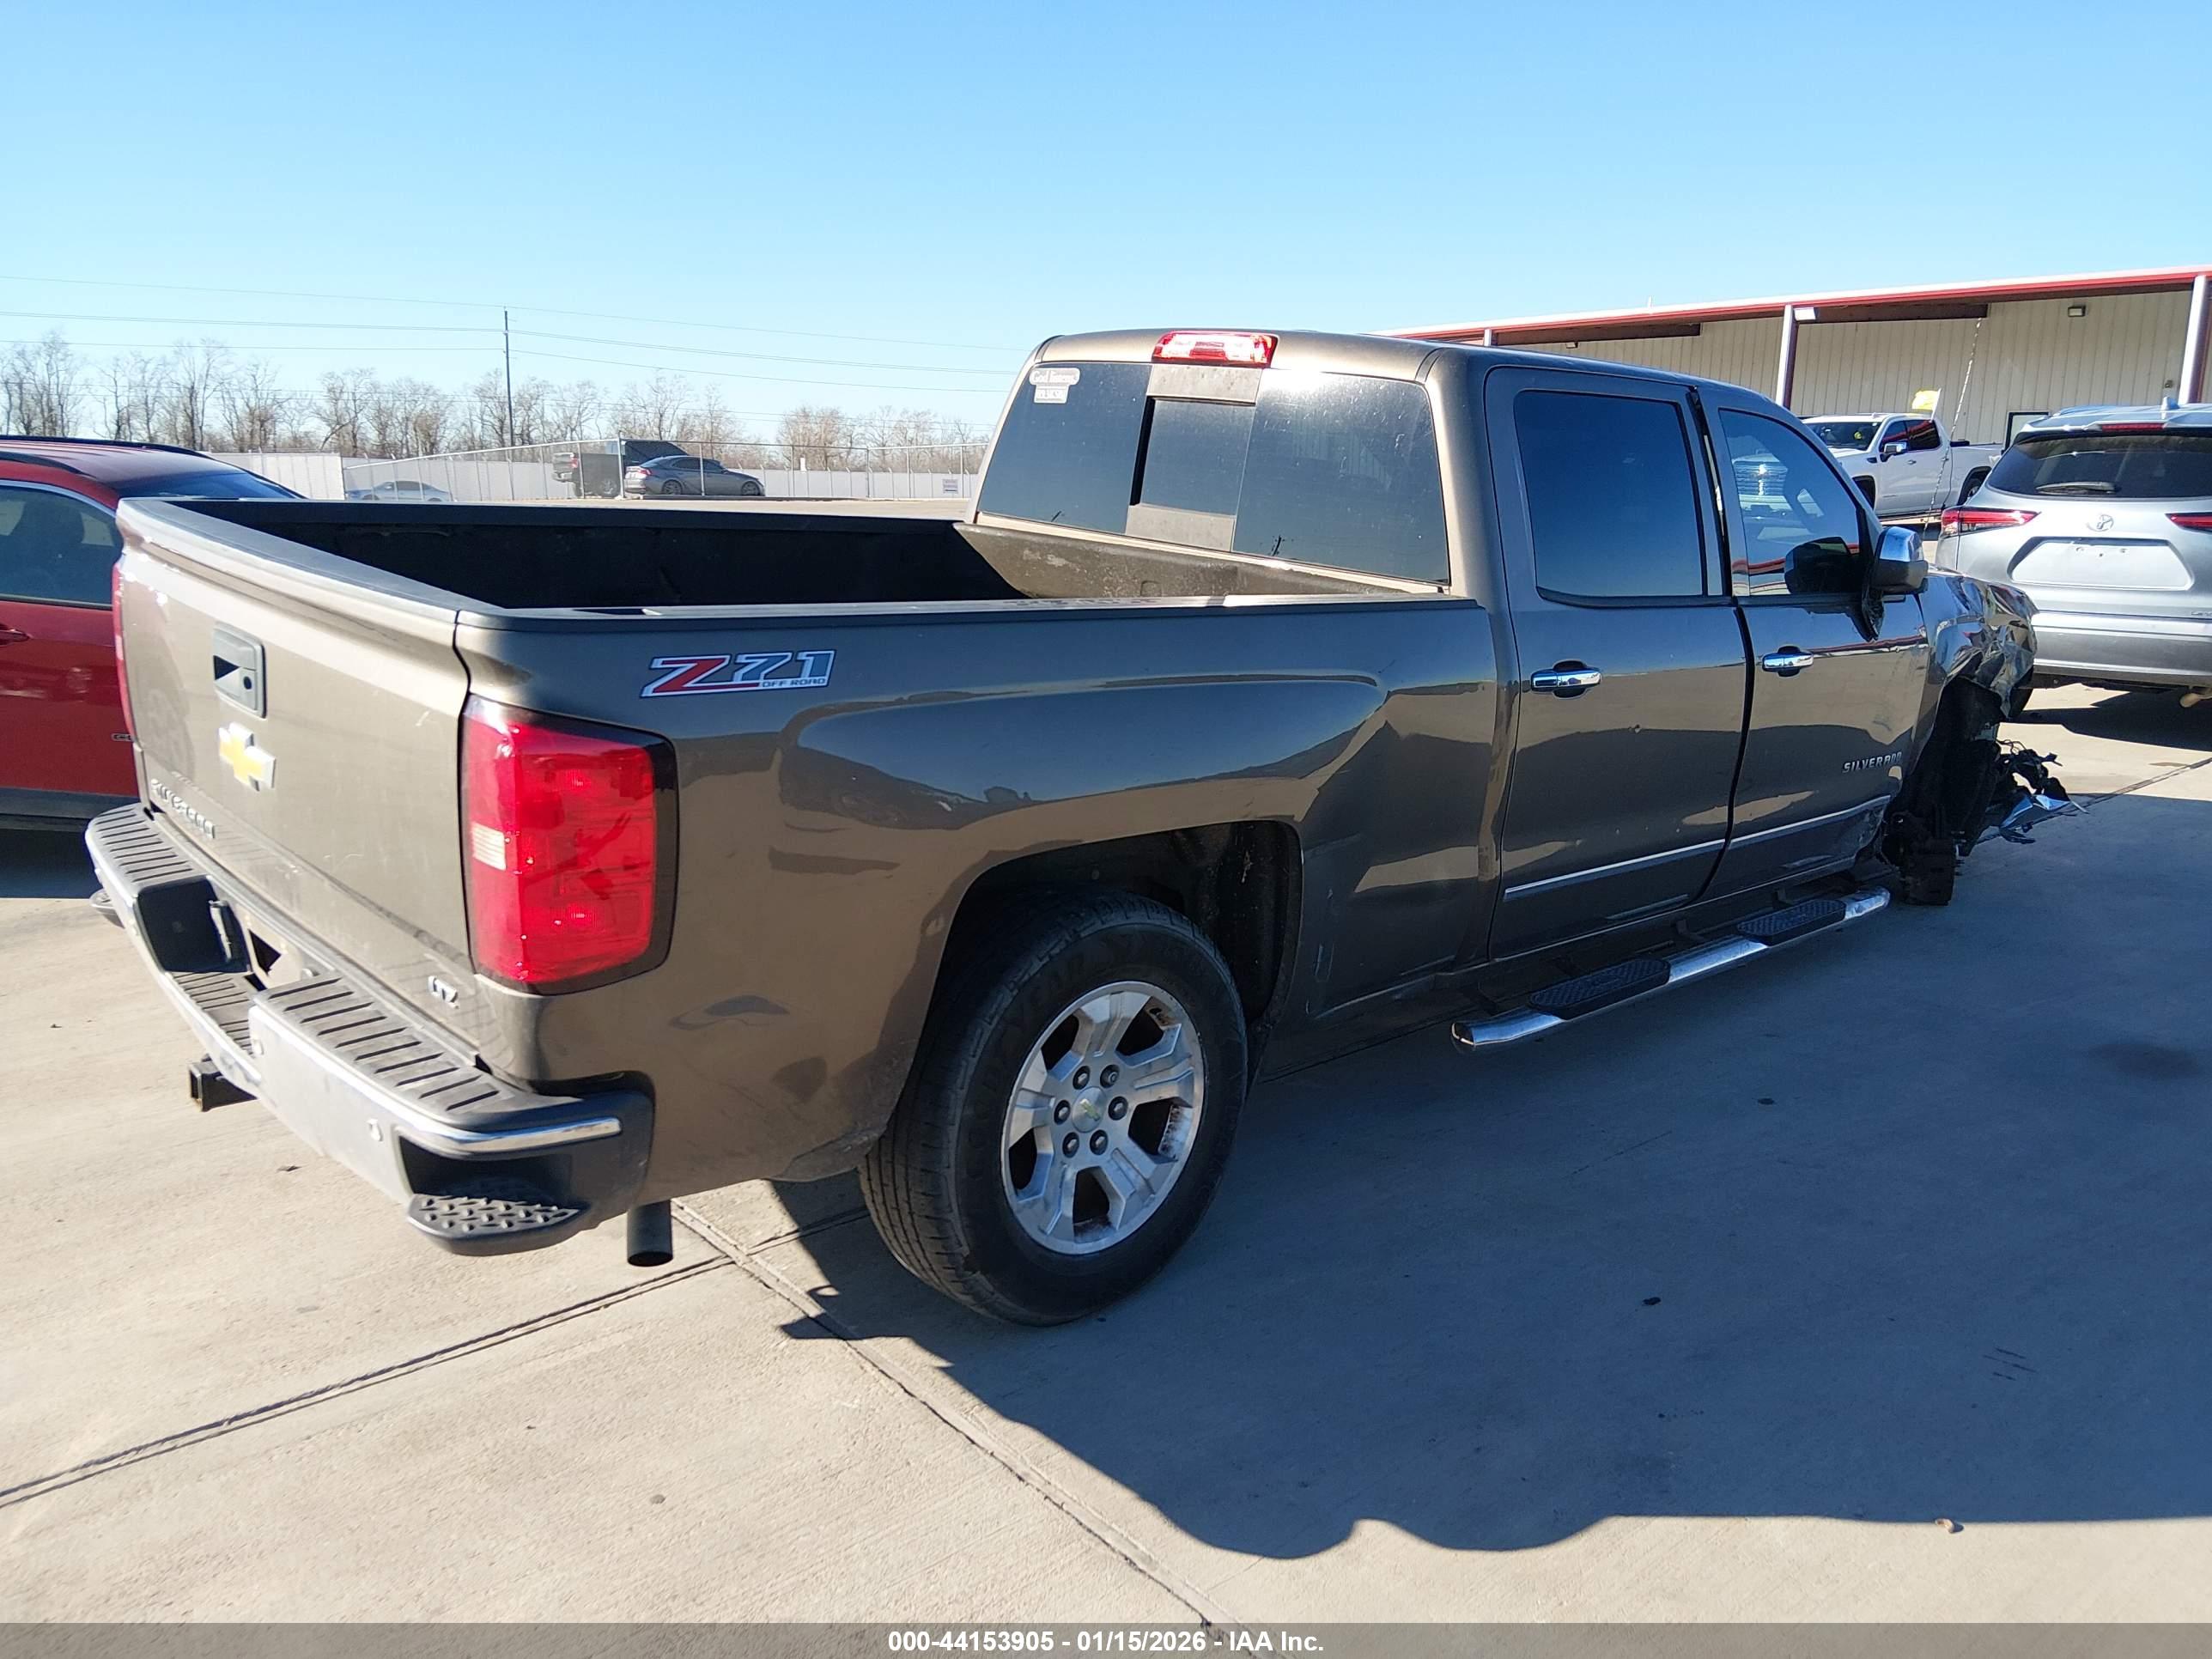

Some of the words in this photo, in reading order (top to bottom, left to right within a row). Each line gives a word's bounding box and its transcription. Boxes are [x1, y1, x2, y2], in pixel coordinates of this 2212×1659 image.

[639, 649, 836, 698] Z71
[762, 680, 785, 689] OFF
[789, 677, 826, 687] ROAD
[1841, 750, 1903, 774] SILVERADO
